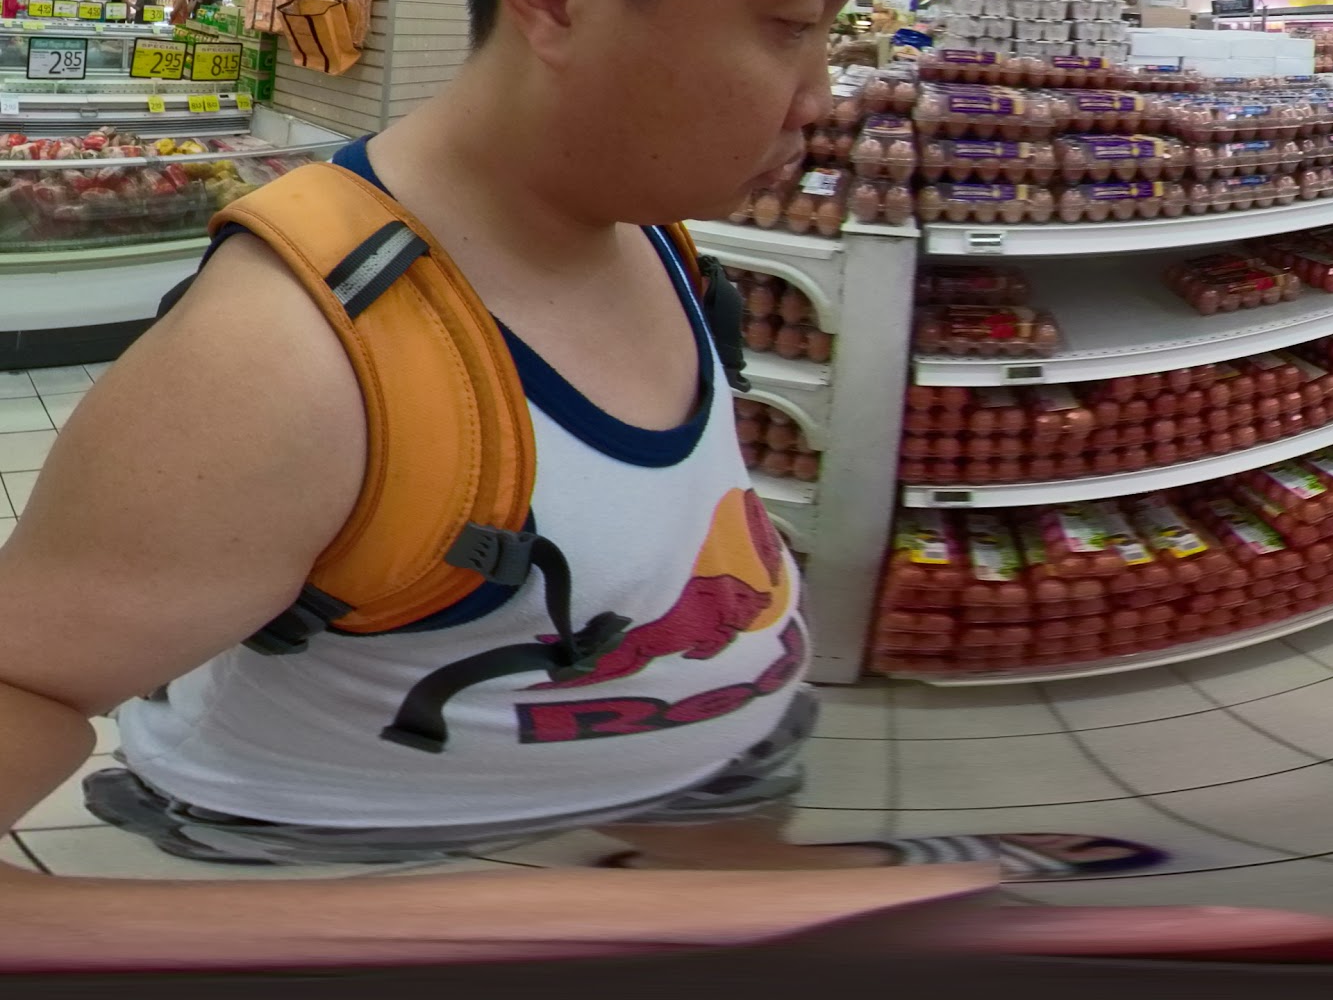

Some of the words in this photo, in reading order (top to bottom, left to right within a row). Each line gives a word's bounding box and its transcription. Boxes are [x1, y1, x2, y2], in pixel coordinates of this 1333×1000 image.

[141, 42, 181, 50] SPECIAL
[48, 51, 83, 74] 2.85
[150, 52, 182, 73] 2.95
[211, 54, 240, 76] 8.15
